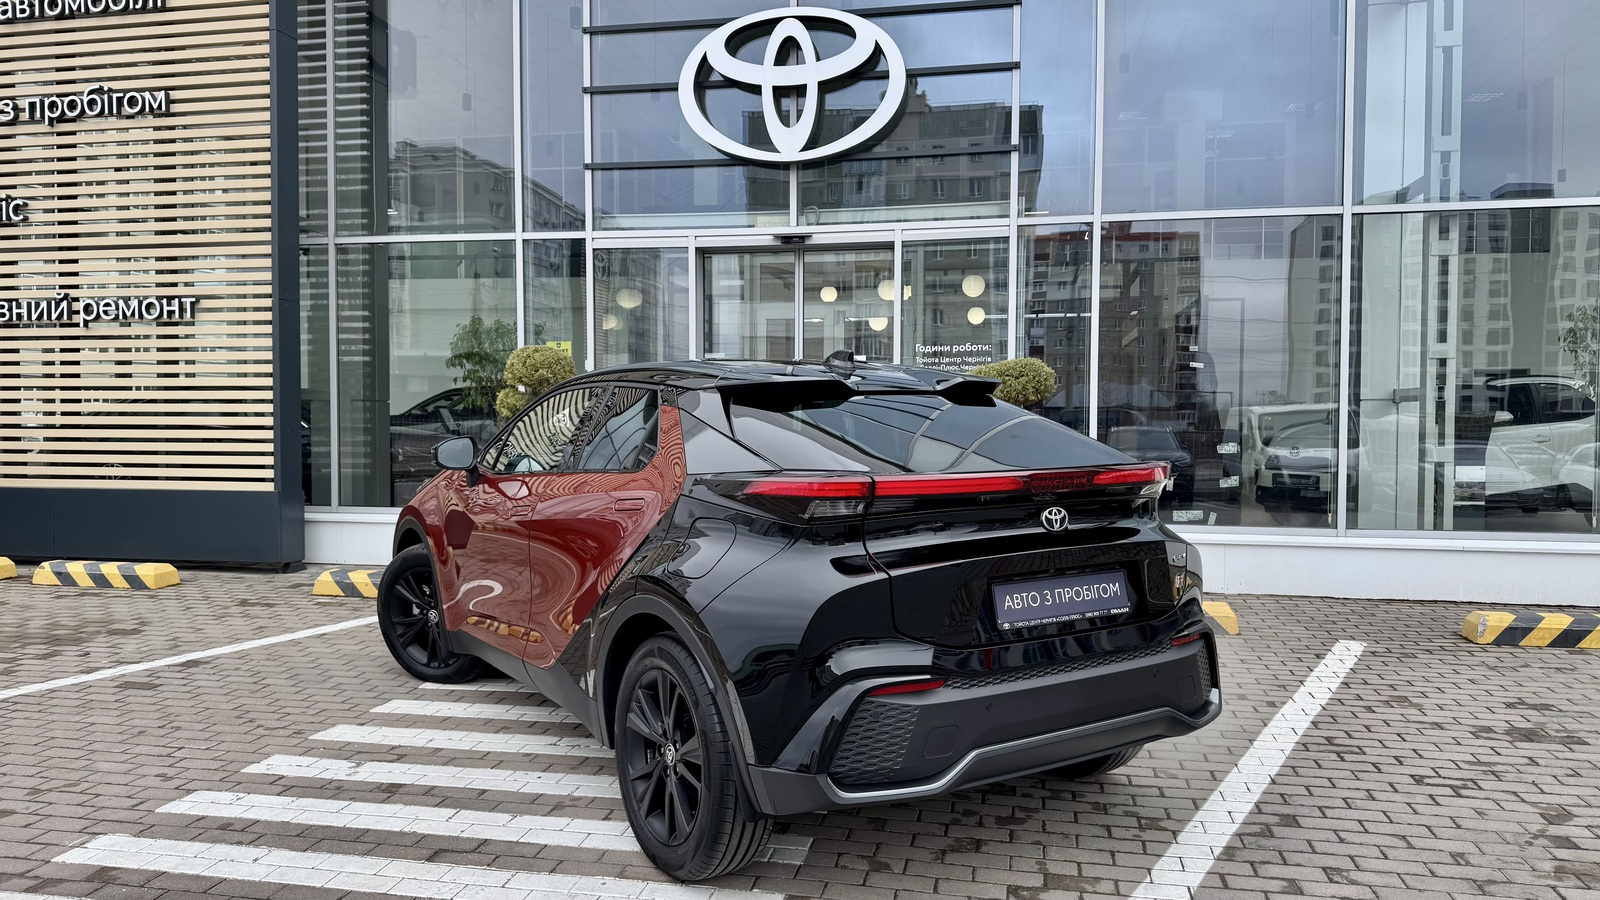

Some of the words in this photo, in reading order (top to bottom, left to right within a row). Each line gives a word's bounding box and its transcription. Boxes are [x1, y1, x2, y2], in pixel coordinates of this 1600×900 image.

[0, 0, 162, 19] автомо
[0, 99, 15, 121] з
[26, 84, 166, 126] пробігом
[2, 193, 24, 221] іс
[0, 292, 68, 321] вний
[80, 297, 196, 328] ремонт
[915, 344, 951, 353] Години
[952, 343, 992, 353] роботи:
[940, 356, 962, 364] Центр
[962, 355, 992, 363] Чернігів
[1004, 591, 1040, 611] АВТО
[1043, 590, 1052, 605] З
[1054, 582, 1121, 604] ПРОБІГОМ
